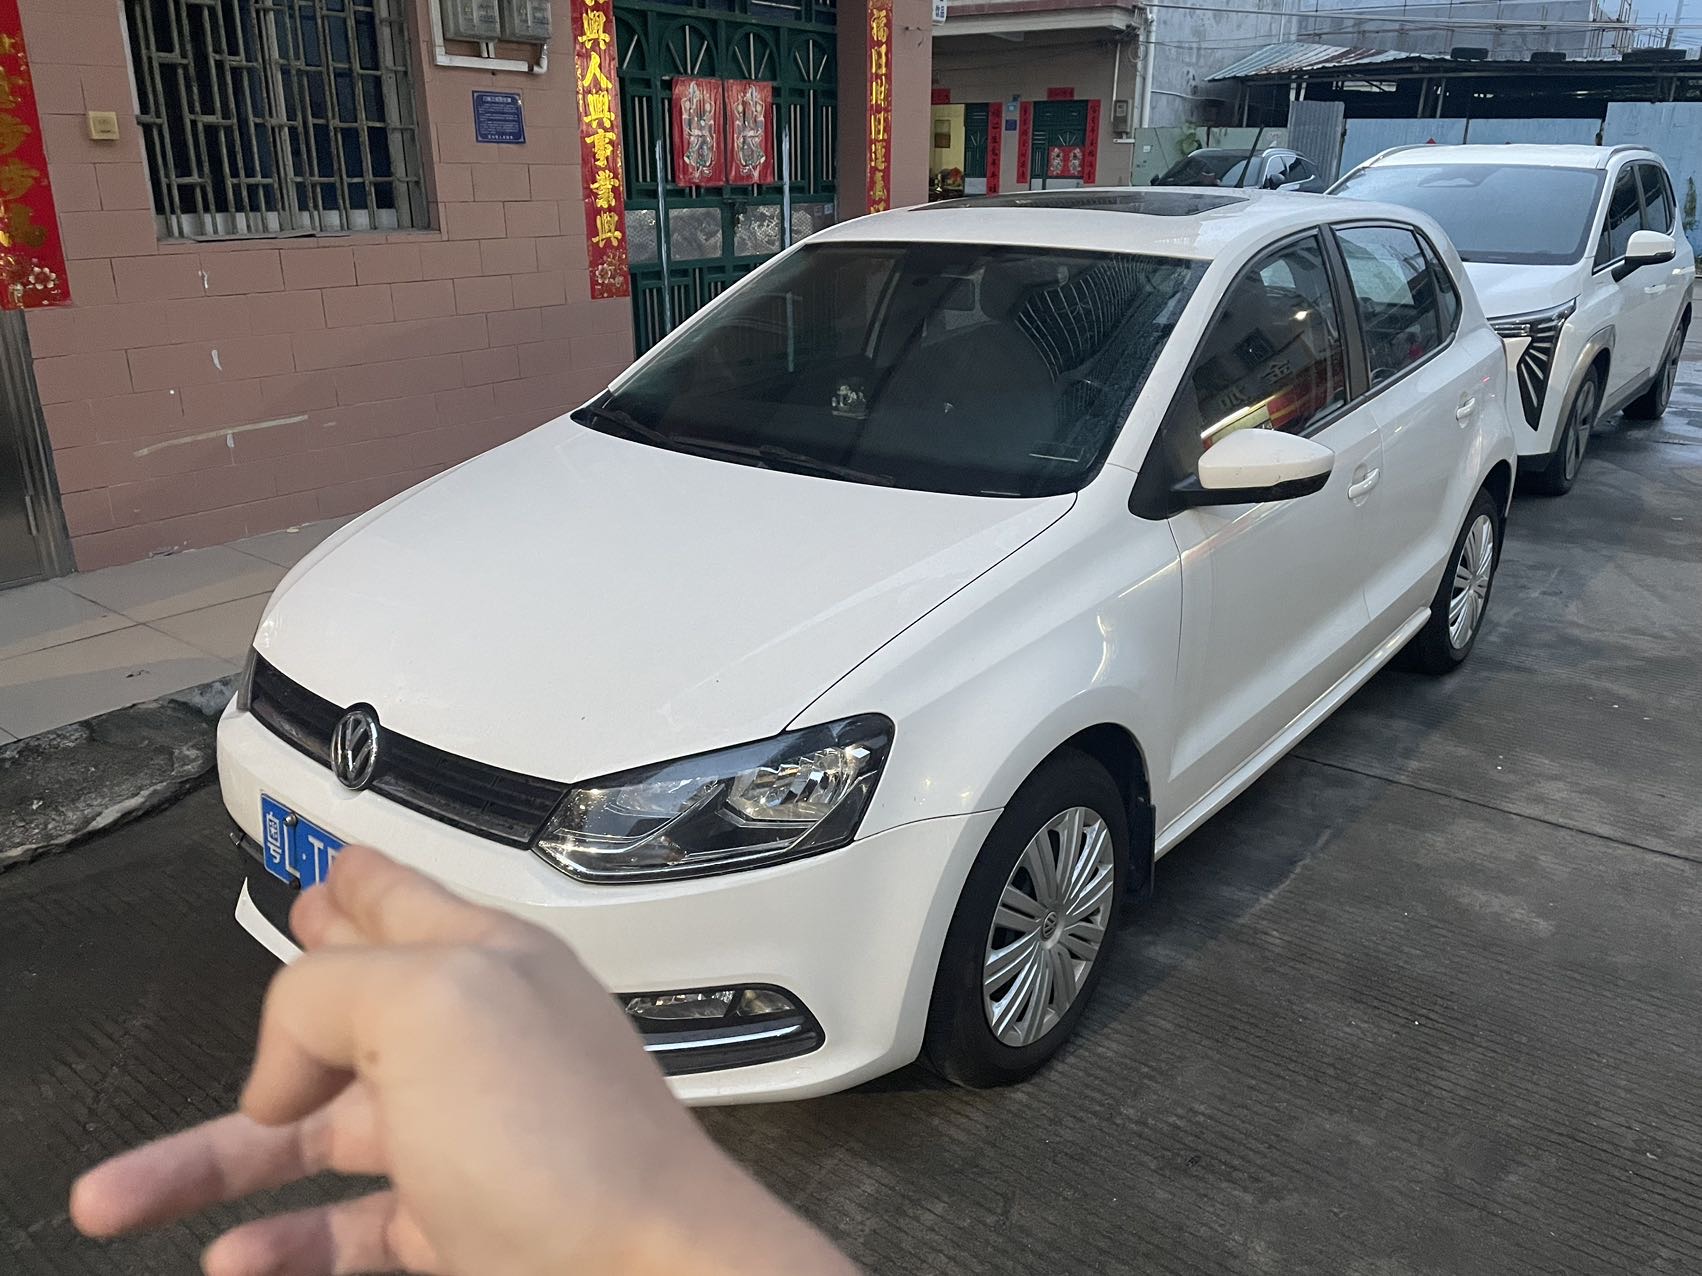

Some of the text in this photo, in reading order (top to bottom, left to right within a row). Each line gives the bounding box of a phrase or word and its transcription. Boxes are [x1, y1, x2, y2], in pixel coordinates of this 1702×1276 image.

[578, 0, 622, 247] 興人興事業興
